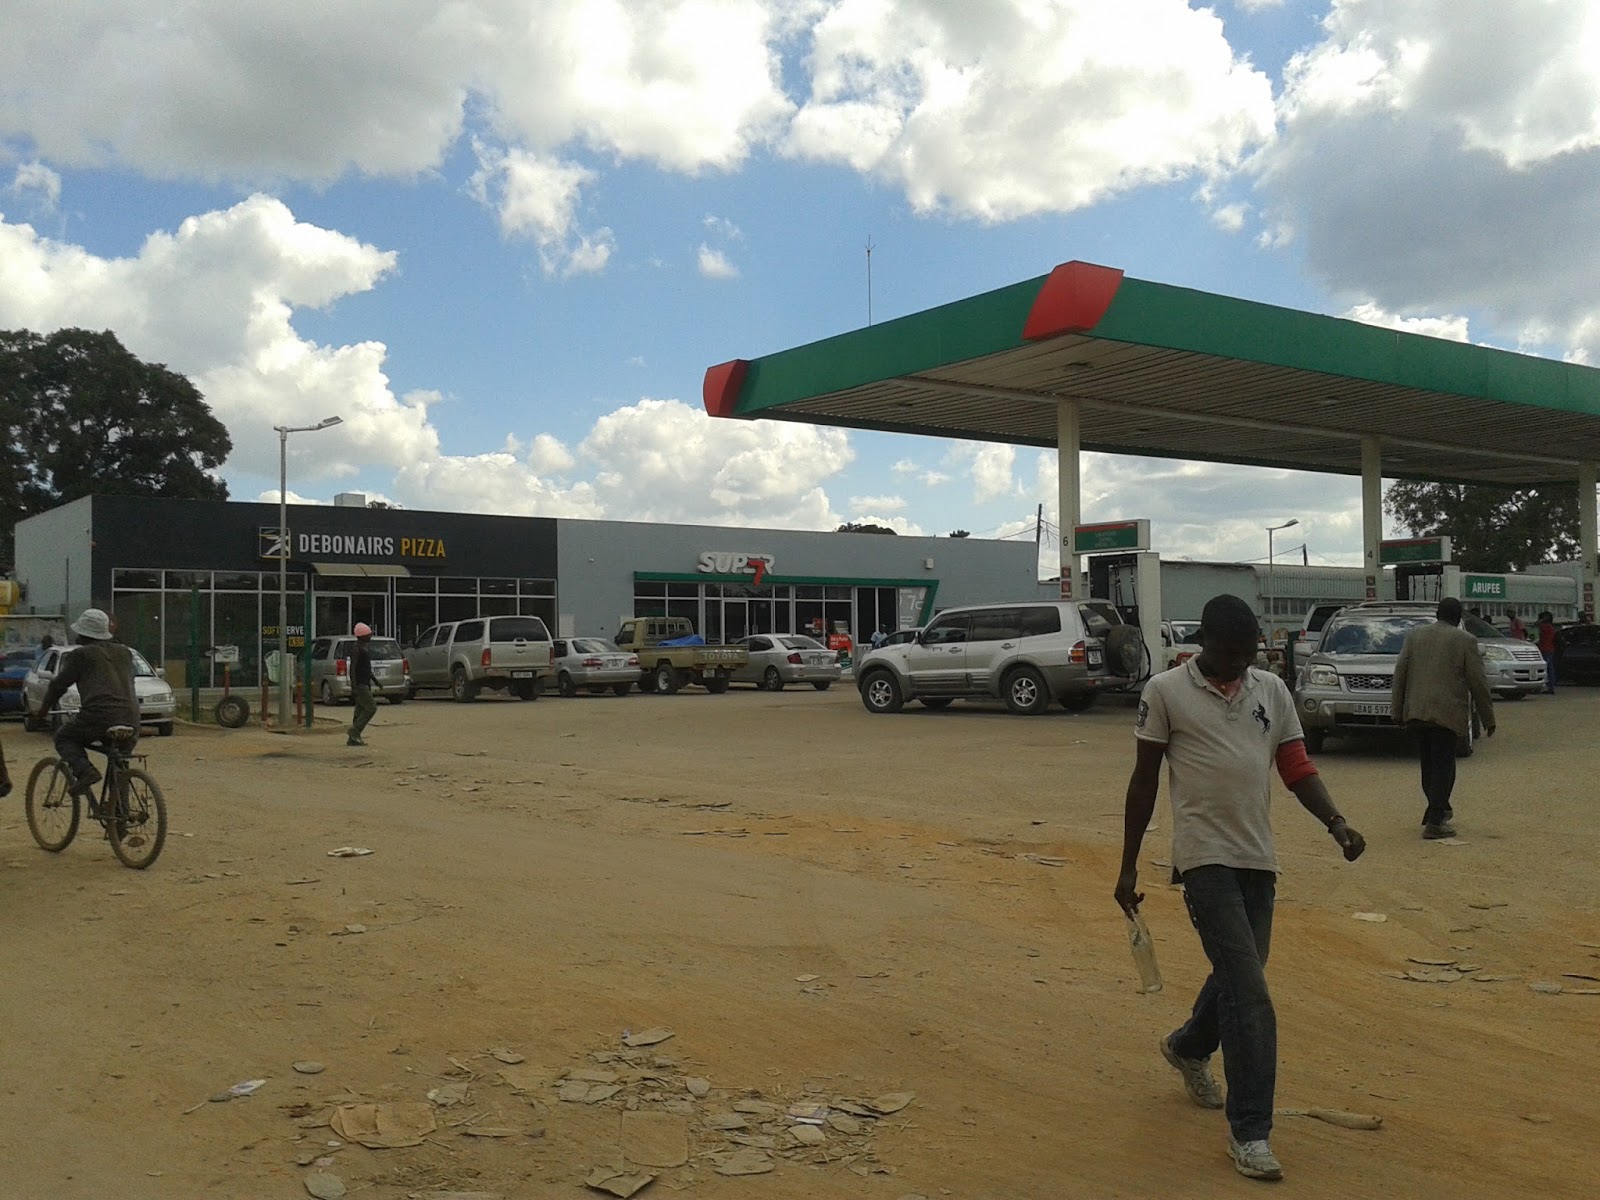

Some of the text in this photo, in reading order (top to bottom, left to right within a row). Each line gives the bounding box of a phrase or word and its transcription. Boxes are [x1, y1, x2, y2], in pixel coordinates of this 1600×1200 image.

[299, 534, 446, 558] DEBONAIRS PIZZA
[1062, 536, 1069, 547] 6
[1366, 550, 1374, 559] 4
[1584, 561, 1591, 569] 2
[746, 560, 766, 587] 7
[1472, 582, 1501, 594] ARUPEE
[284, 625, 304, 636] ERVE
[702, 652, 739, 661] TOYOTA
